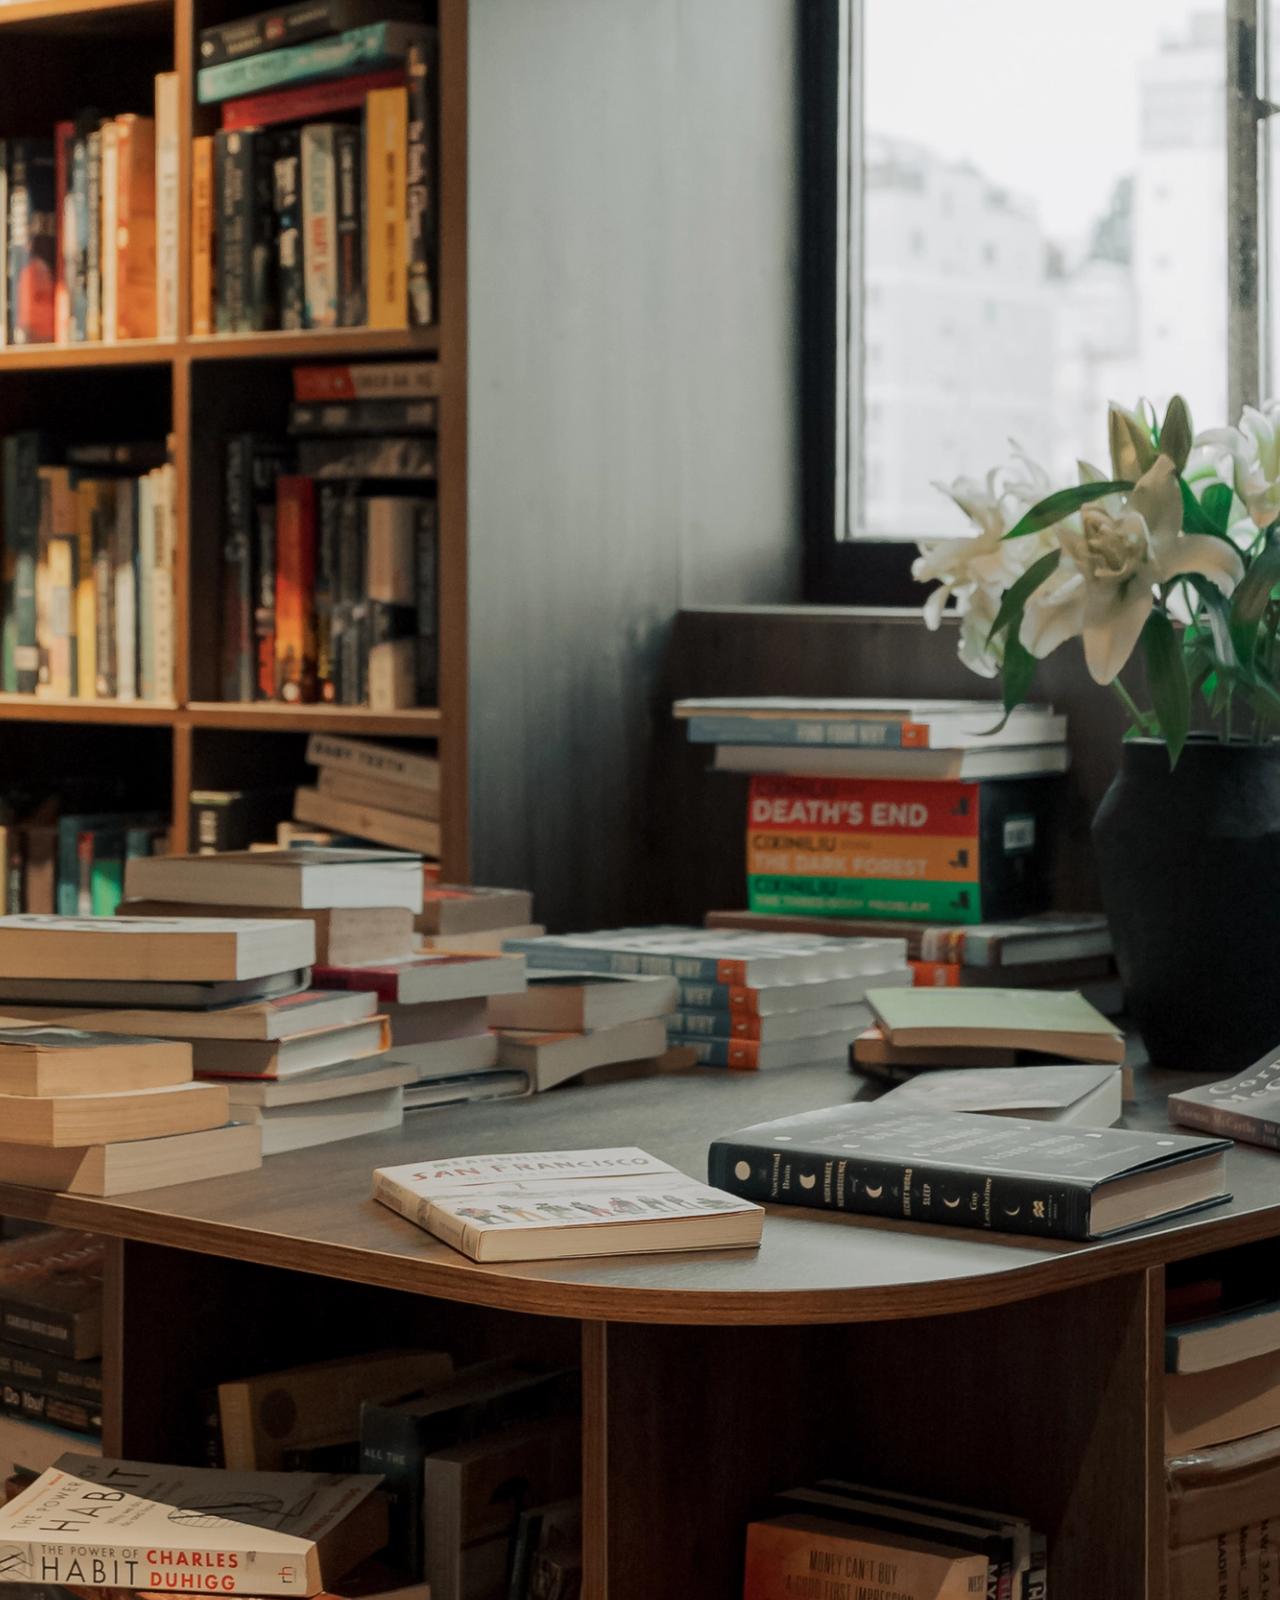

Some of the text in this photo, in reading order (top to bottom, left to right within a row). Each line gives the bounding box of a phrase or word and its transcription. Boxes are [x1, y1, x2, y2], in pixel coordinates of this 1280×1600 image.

[751, 798, 929, 829] DEATH'S END
[490, 1156, 650, 1178] FRANCISCO
[41, 1544, 139, 1558] THE POWER OF
[146, 1550, 238, 1568] CHARLES
[1217, 1532, 1229, 1581] MADE
[41, 1556, 139, 1586] HABIT
[150, 1571, 236, 1590] DUHIGG
[984, 1563, 999, 1599] MY
[1219, 1584, 1229, 1600] IN
